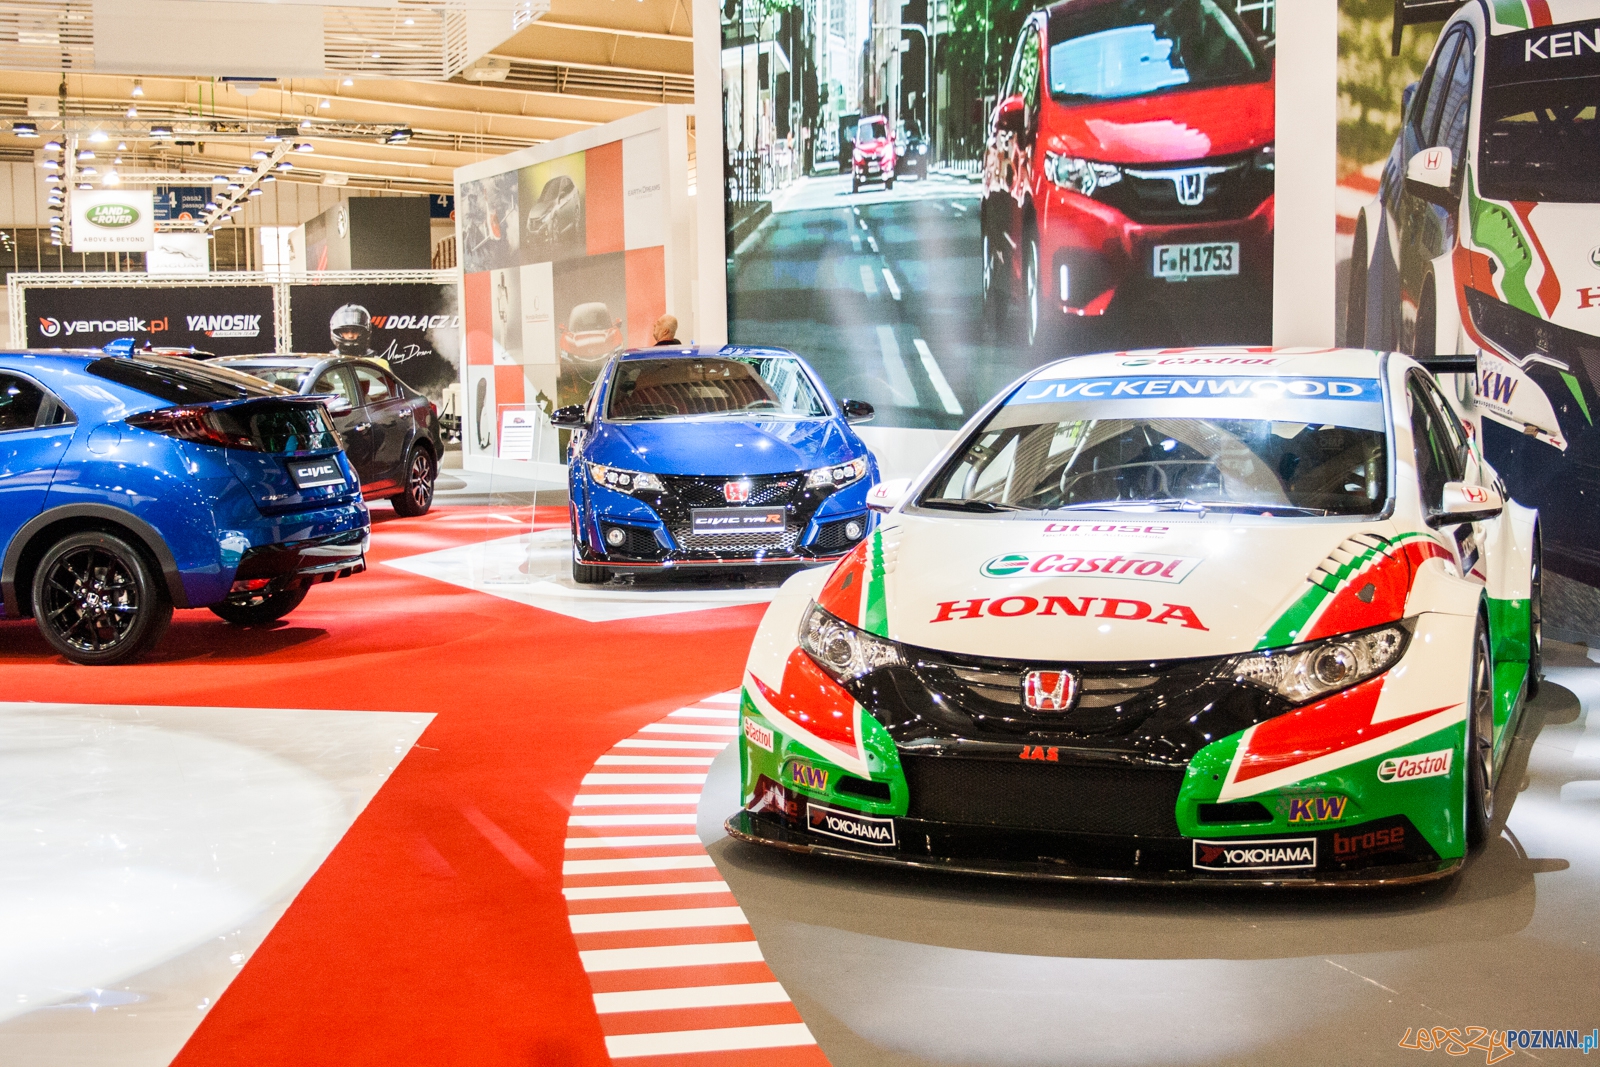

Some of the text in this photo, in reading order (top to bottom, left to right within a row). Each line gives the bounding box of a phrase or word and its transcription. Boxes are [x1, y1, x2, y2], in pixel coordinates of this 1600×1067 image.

[95, 206, 124, 215] LAND
[97, 215, 133, 224] ROVER
[63, 316, 169, 334] yanosik.pl
[186, 314, 262, 331] YANOSIK
[385, 315, 450, 332] DOŁĄCZ
[1157, 357, 1278, 365] Castrol
[298, 465, 334, 477] CIVIC
[695, 517, 740, 525] CIVIC
[1043, 523, 1170, 534] brose
[1029, 553, 1183, 578] Castrol
[929, 596, 1210, 632] HONDA
[750, 722, 772, 749] Castrol
[1019, 745, 1059, 762] JAS
[1396, 753, 1448, 779] Castrol
[792, 762, 829, 791] KW
[1288, 796, 1348, 822] KW
[826, 815, 891, 840] YOKOHAMA
[1333, 826, 1405, 854] brose
[1224, 847, 1312, 864] YOKOHAMA
